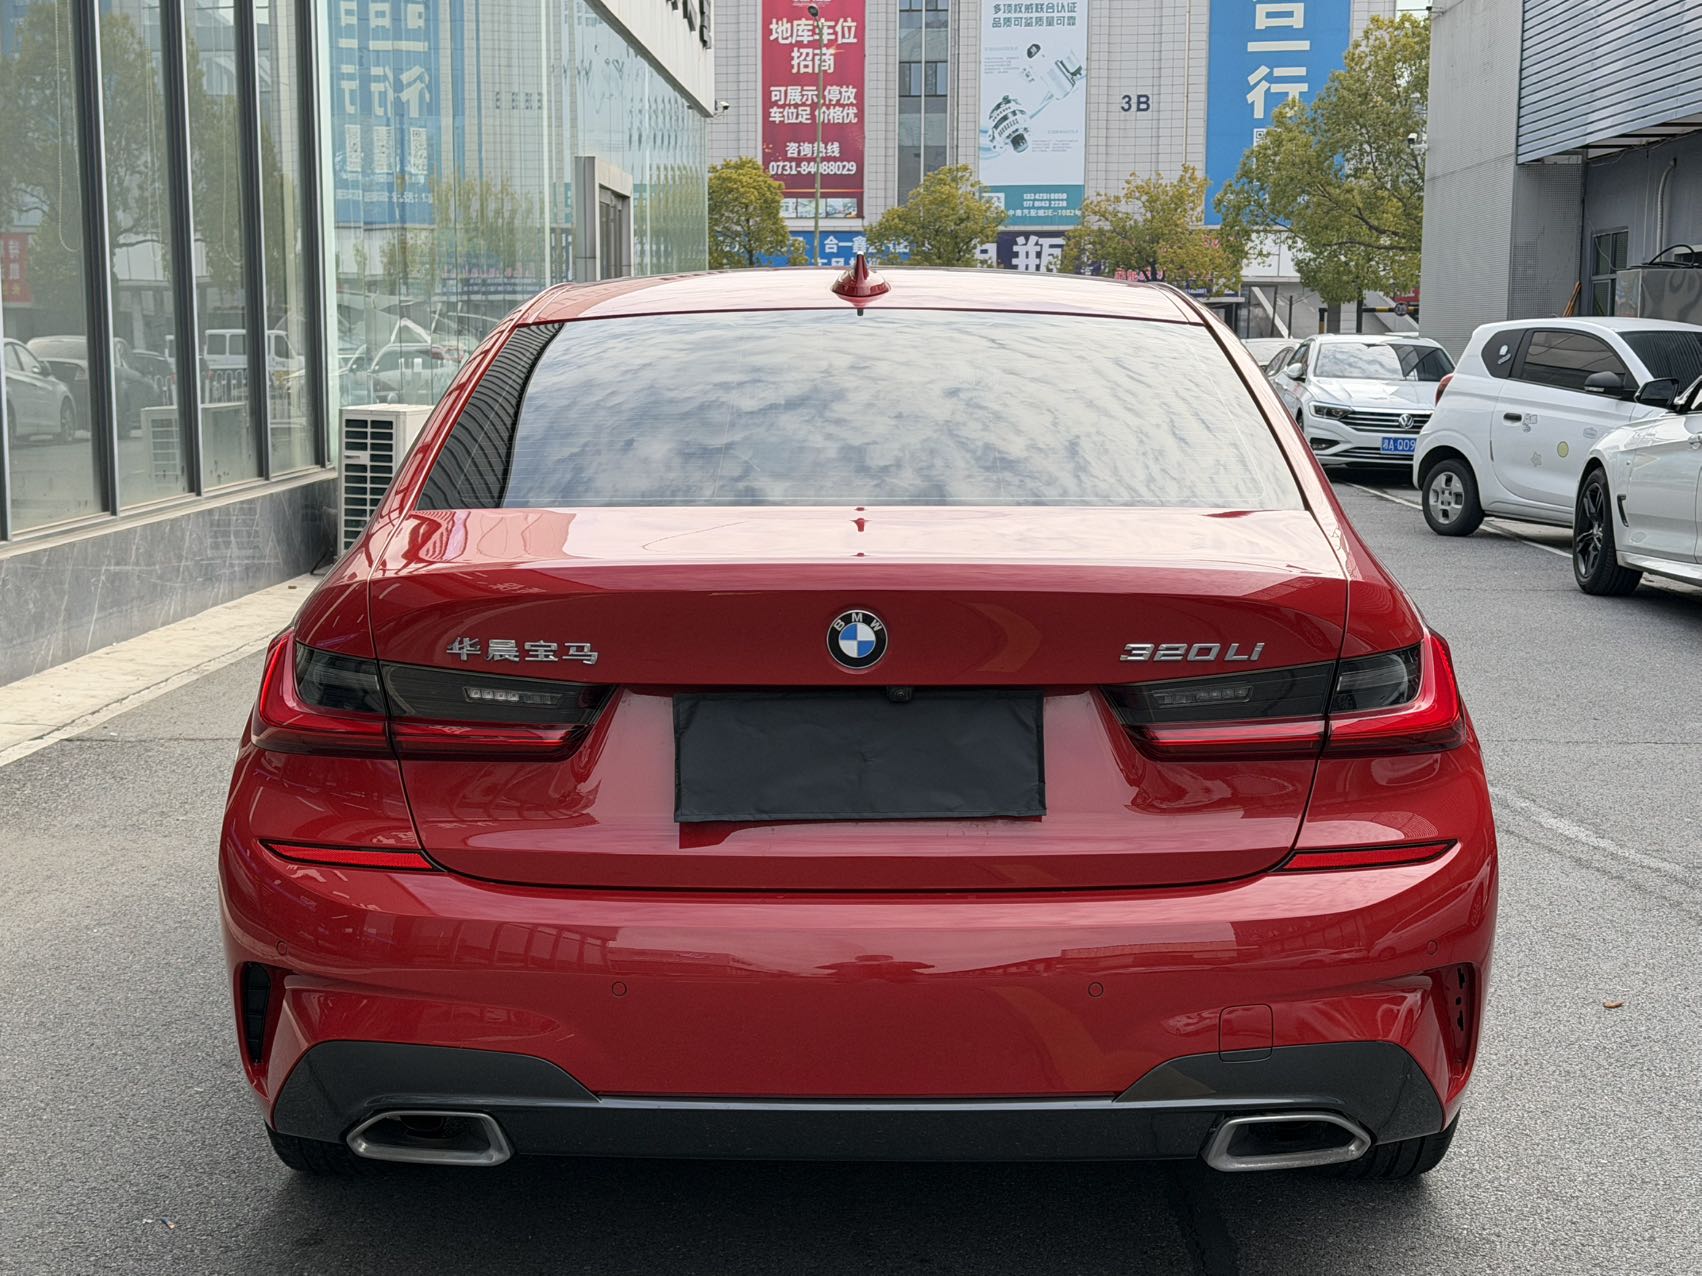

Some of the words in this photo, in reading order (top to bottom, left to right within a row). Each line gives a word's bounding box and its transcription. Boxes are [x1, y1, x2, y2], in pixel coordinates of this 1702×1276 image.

[769, 18, 857, 44] 地库车位
[791, 47, 834, 73] 招商
[770, 86, 818, 104] 可展示
[824, 86, 857, 104] 停放
[1121, 94, 1150, 112] 3B
[769, 106, 811, 123] 车位足
[815, 106, 857, 123] 价格优
[785, 142, 840, 157] 咨询热线
[833, 612, 882, 632] BMW
[447, 637, 598, 664] 华晨宝马
